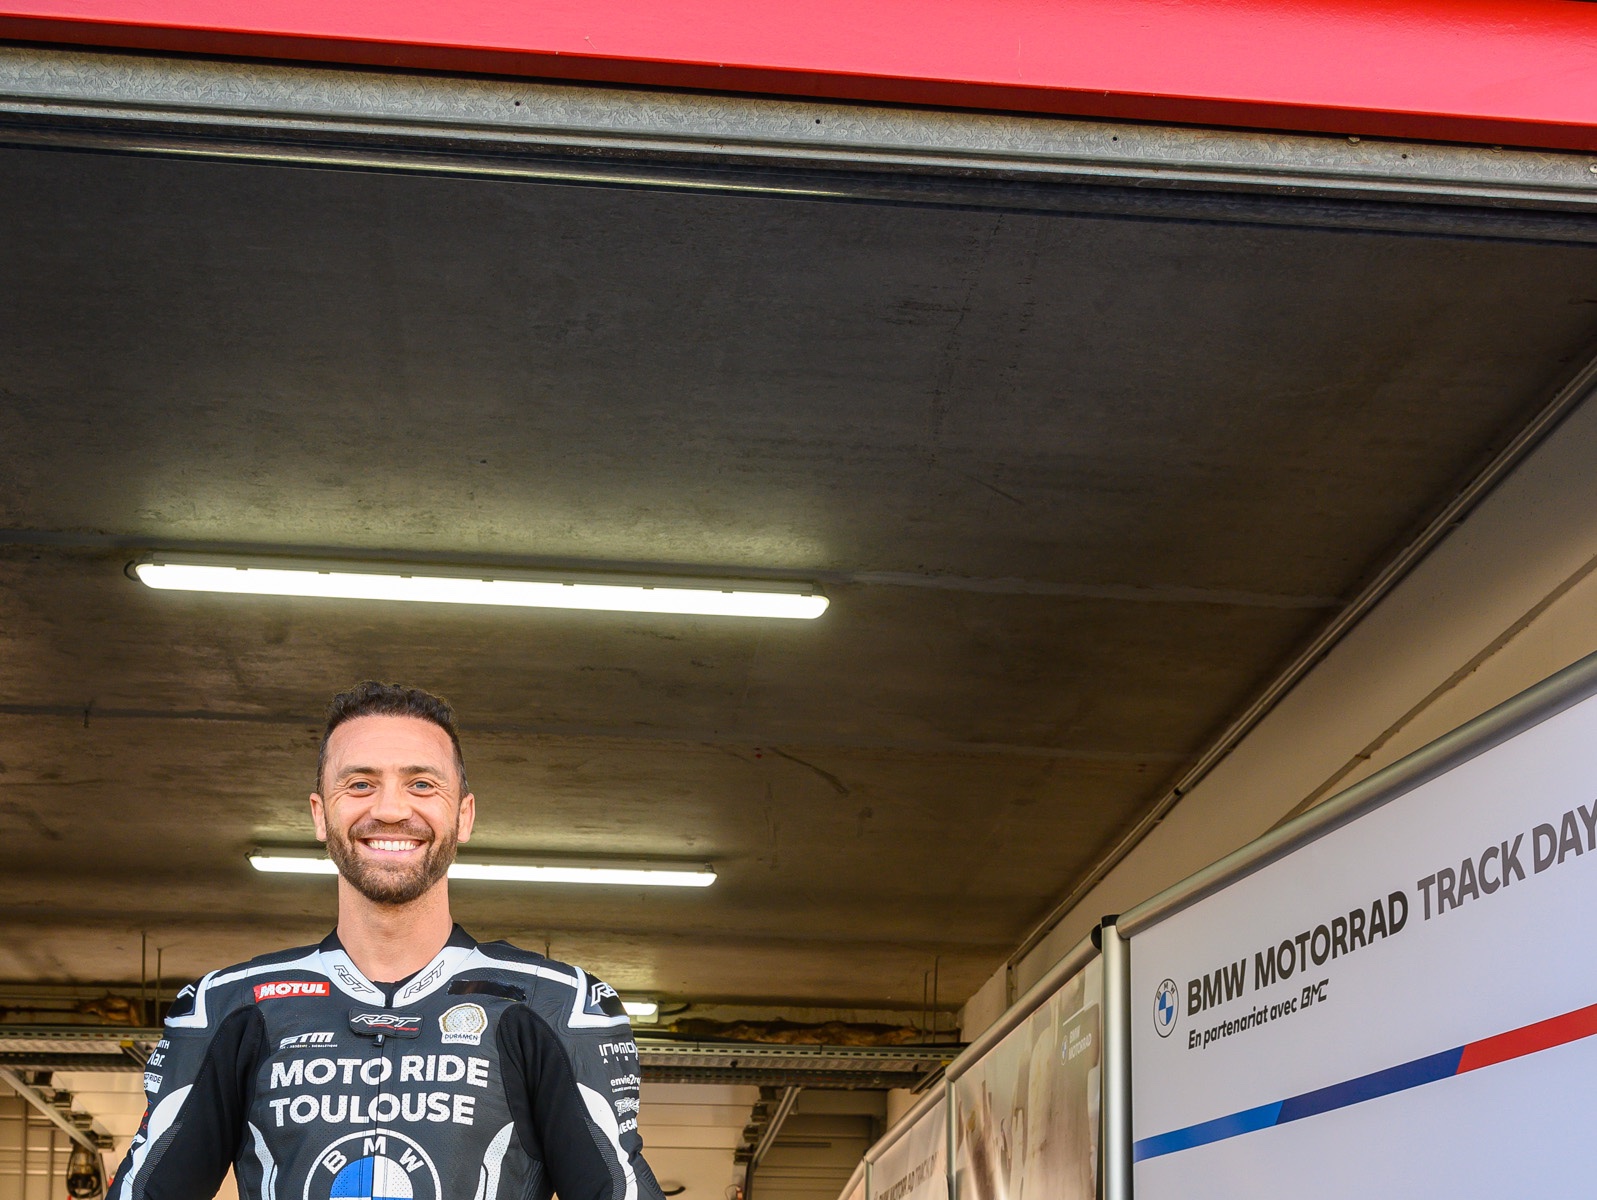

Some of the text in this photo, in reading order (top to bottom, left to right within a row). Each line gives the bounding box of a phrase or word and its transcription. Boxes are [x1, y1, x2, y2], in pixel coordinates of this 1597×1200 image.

[1187, 798, 1597, 1017] BMW MOTORRAD TRACK DAY
[259, 982, 327, 999] MOTUL
[334, 964, 375, 994] RST
[403, 960, 445, 998] RST
[351, 1013, 421, 1028] RST
[444, 1033, 479, 1041] DURAMEN
[1188, 1029, 1202, 1050] En
[1203, 1005, 1269, 1049] partenariat
[1270, 997, 1298, 1022] avec
[269, 1054, 490, 1090] MOTO RIDE
[269, 1092, 476, 1127] TOULOUSE
[322, 1136, 425, 1175] BMW
